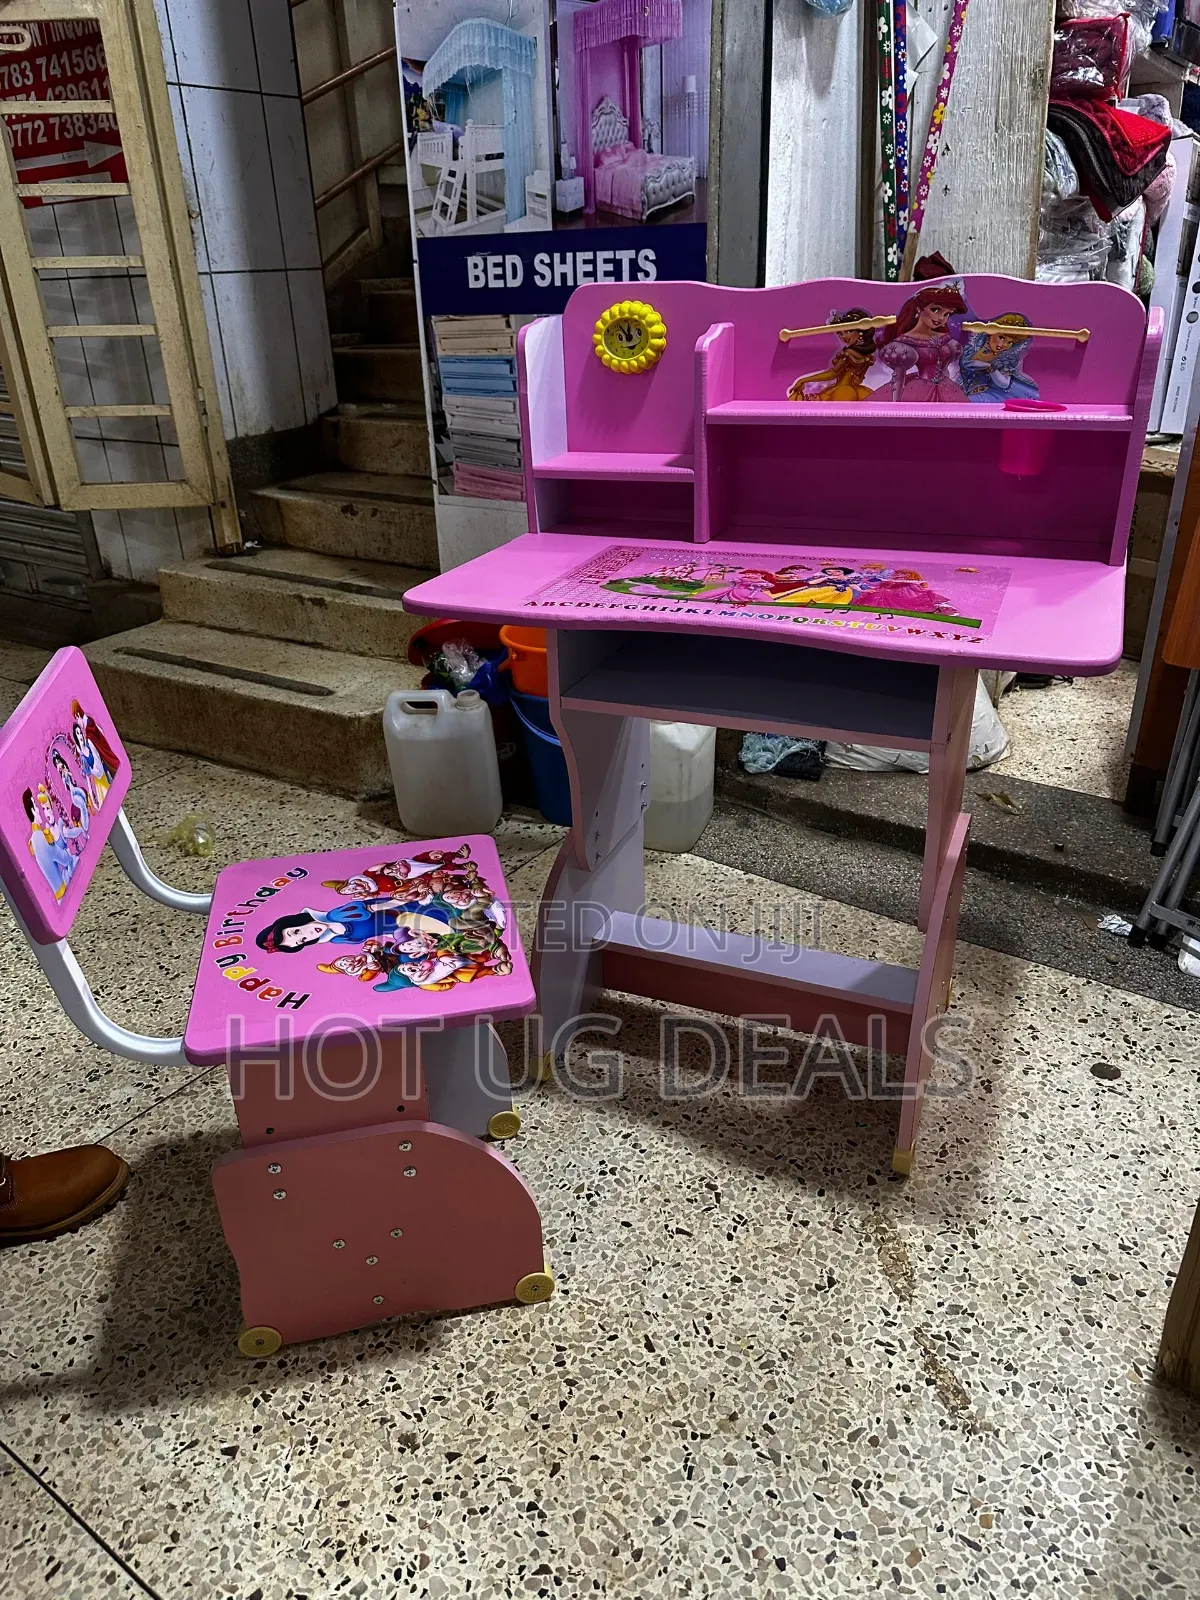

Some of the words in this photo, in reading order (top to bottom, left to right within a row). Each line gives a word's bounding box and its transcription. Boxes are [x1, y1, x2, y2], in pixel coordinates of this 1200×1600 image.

[0, 61, 34, 90] 783
[467, 253, 524, 289] BED
[533, 248, 658, 288] SHEETS
[213, 866, 309, 949] Birthday
[215, 952, 310, 1010] Happy
